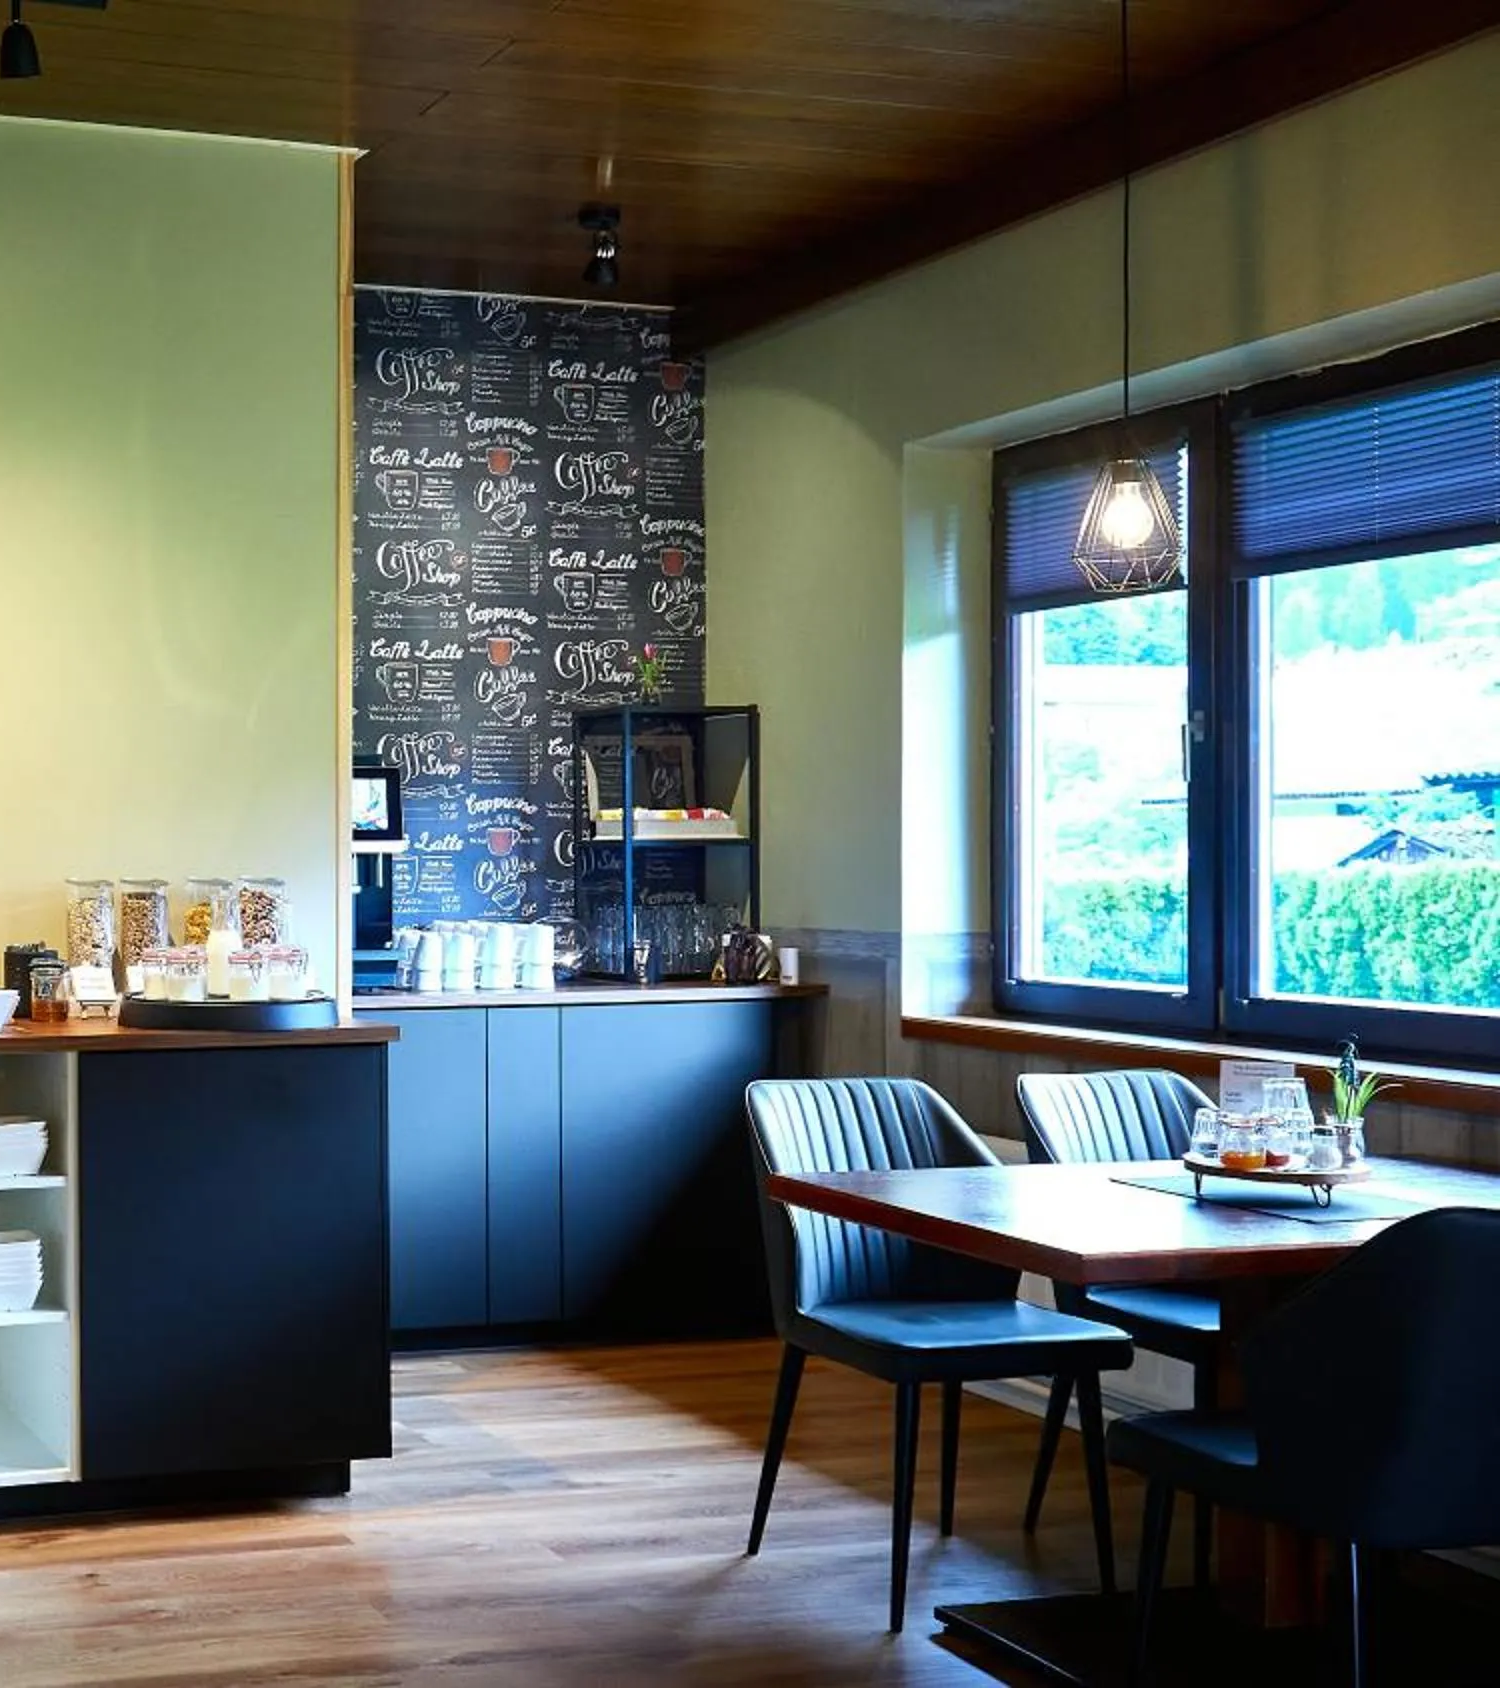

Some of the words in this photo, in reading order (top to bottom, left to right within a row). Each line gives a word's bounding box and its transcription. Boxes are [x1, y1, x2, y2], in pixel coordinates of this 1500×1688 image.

[375, 347, 455, 401] Coffee
[421, 370, 461, 395] Shop
[591, 362, 639, 383] Latte
[414, 448, 464, 469] Latte
[554, 451, 629, 503] Coffee
[598, 474, 636, 499] Shop
[375, 538, 456, 593] Coffee
[591, 549, 639, 571] Latte
[421, 562, 461, 588] Shop
[414, 639, 464, 661] Latte
[554, 639, 629, 696] Coffee
[598, 662, 636, 687] Shop
[421, 753, 461, 778] Shop
[414, 832, 465, 852] Latte
